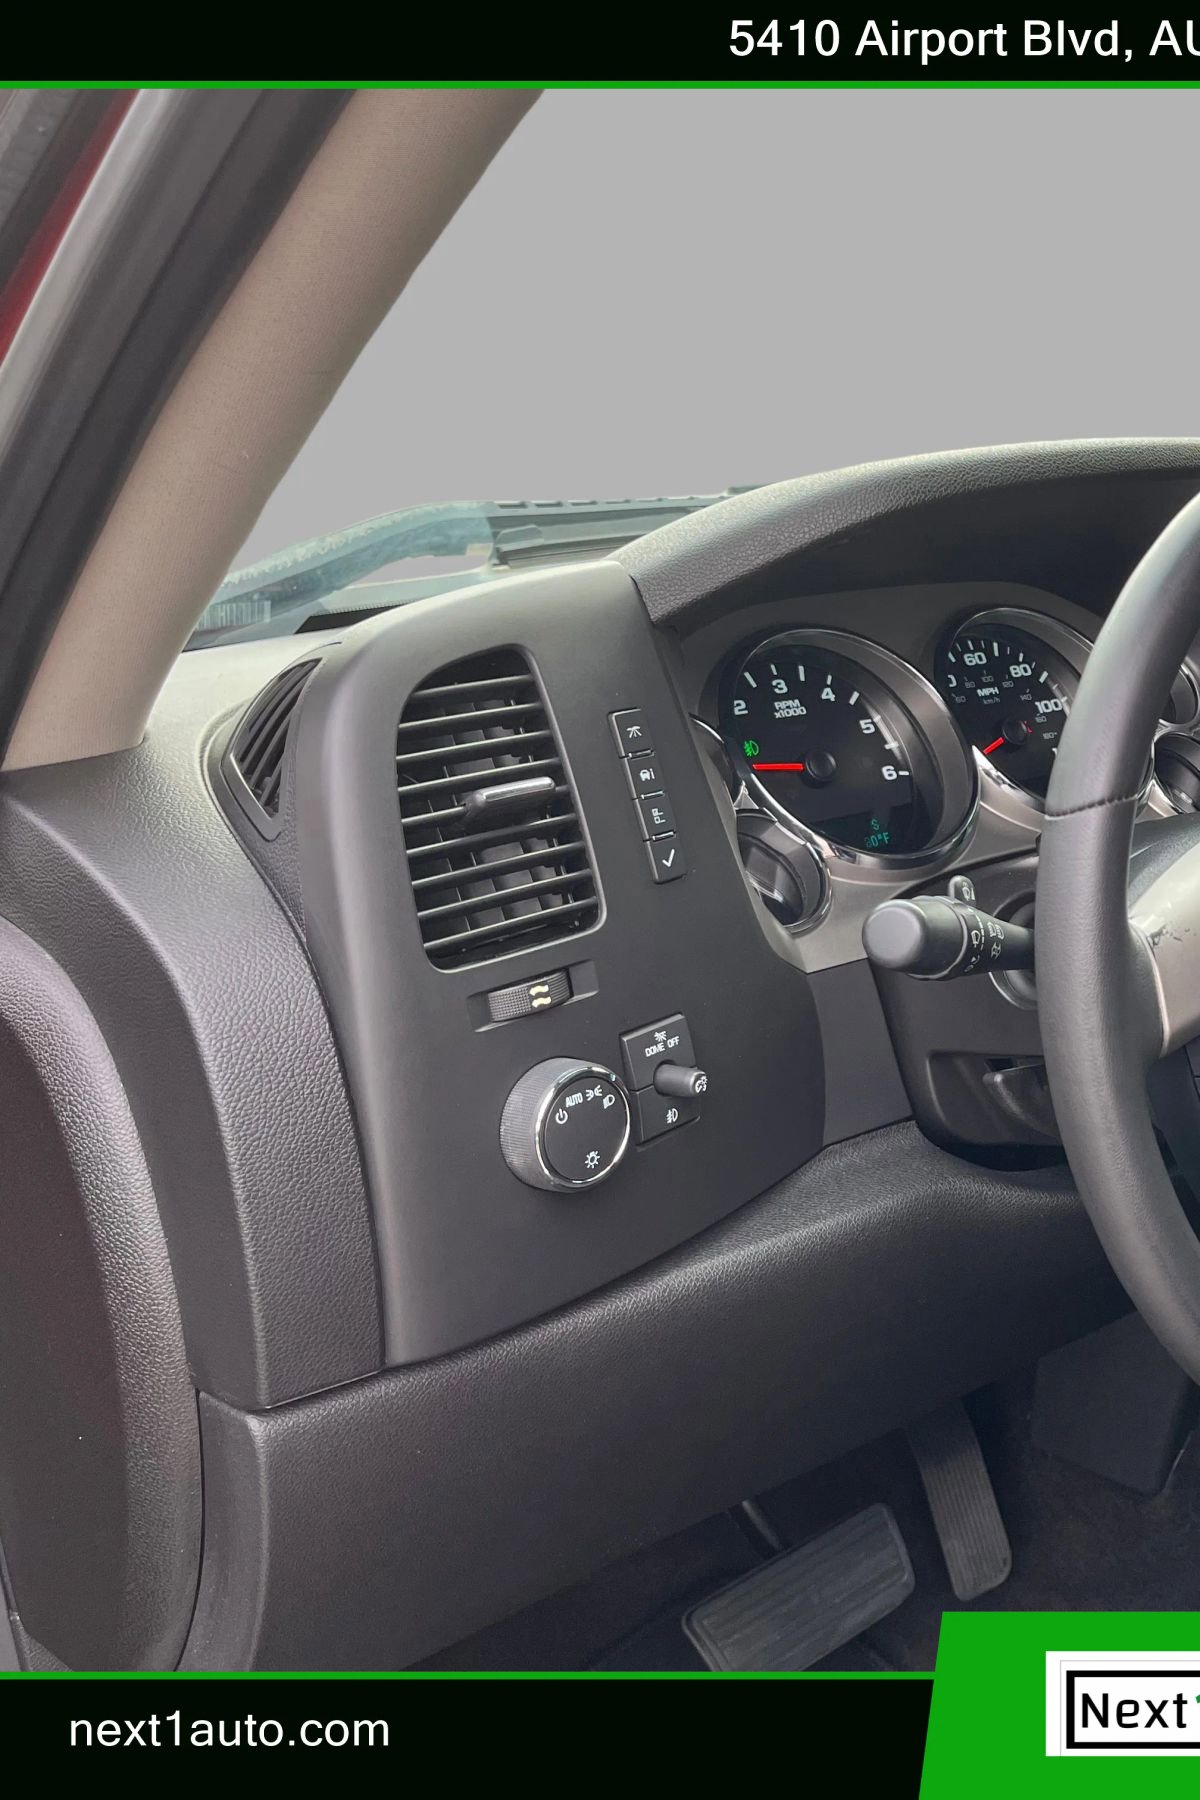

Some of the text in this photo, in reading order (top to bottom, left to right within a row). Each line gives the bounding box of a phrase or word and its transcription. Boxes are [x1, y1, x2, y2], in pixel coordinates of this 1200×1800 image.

[963, 652, 987, 666] 60
[1009, 664, 1032, 678] 80
[771, 679, 788, 694] 3
[977, 686, 999, 697] MPH
[821, 687, 836, 702] 4
[733, 700, 749, 716] 2
[774, 699, 801, 711] RPM
[774, 706, 807, 719] x1000
[1035, 698, 1062, 713] 100
[859, 719, 876, 734] 5
[881, 765, 898, 781] 6
[644, 1036, 680, 1057] DOME OFF
[565, 1092, 584, 1108] AUTO
